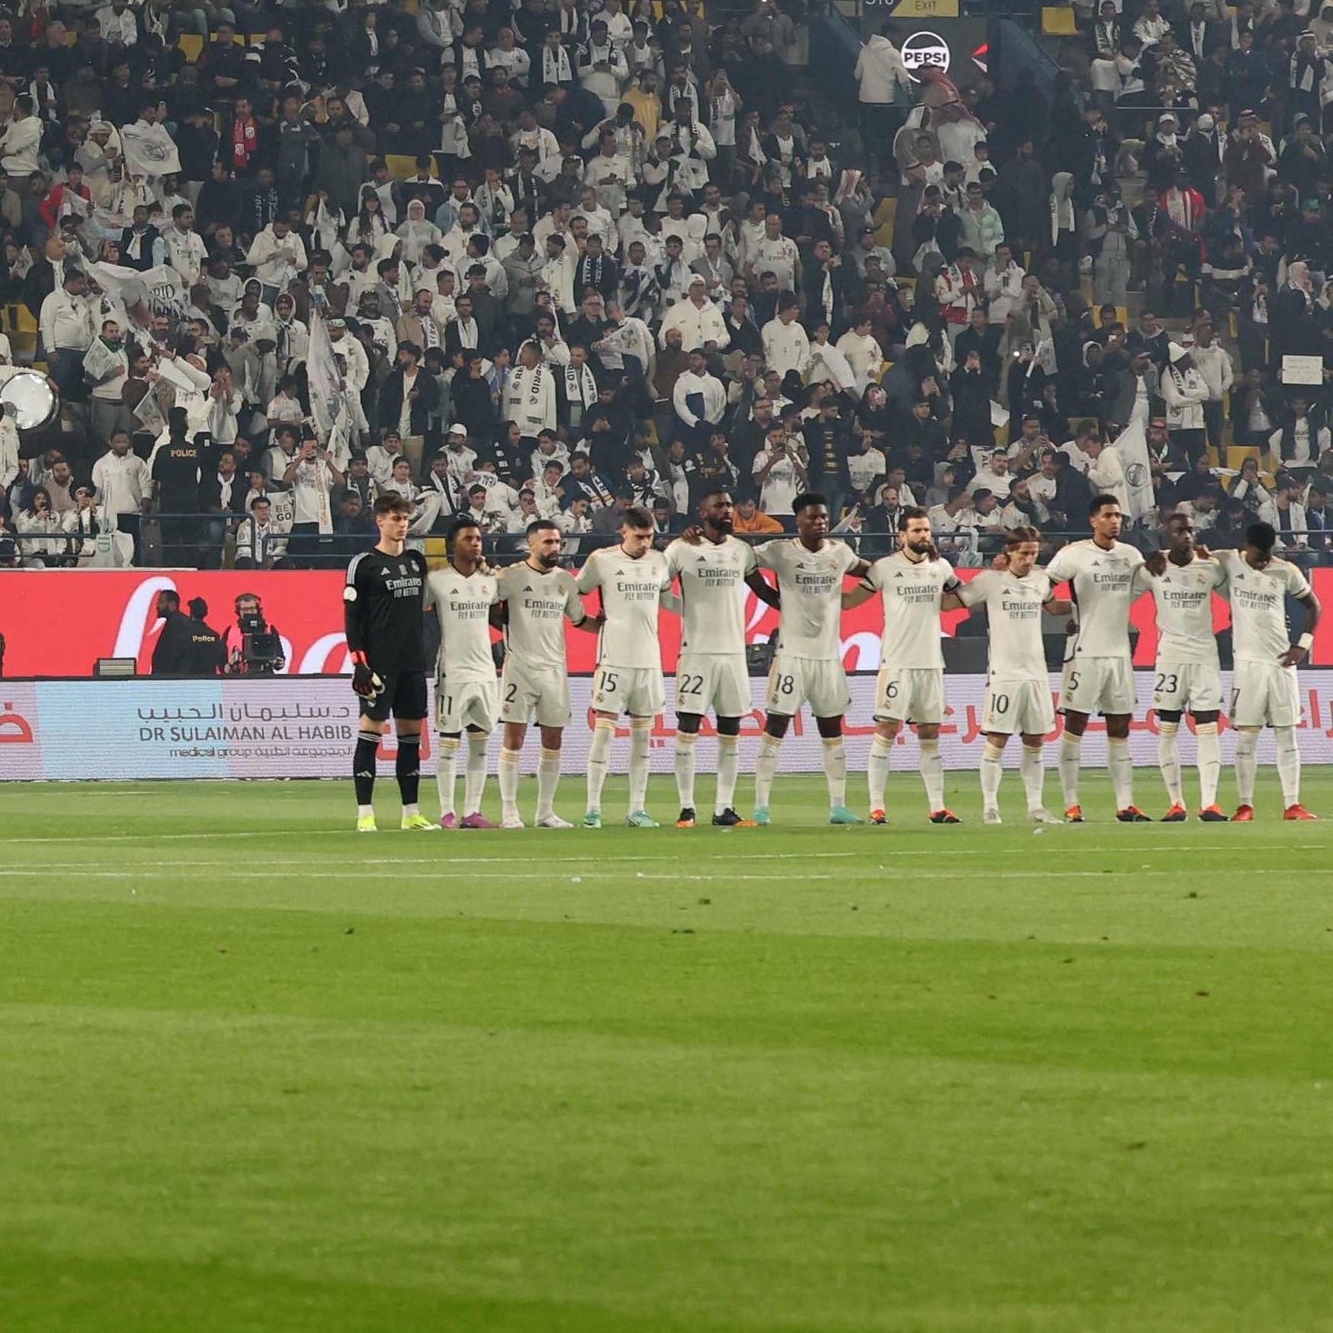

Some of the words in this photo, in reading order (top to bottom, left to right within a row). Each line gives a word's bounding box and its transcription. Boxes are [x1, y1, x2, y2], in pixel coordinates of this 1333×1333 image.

[915, 0, 937, 11] EXIT
[904, 52, 947, 63] PEPSI
[170, 449, 197, 457] POLICE
[276, 513, 292, 522] GO
[697, 568, 740, 578] Emirates
[795, 574, 837, 585] Emirates
[385, 577, 422, 591] Emirates
[617, 582, 659, 592] Emirates
[896, 584, 939, 596] Emirates
[1162, 589, 1207, 601] Emirates
[1234, 587, 1277, 602] Emirates
[192, 634, 215, 643] Police
[600, 671, 618, 692] 15
[679, 674, 703, 695] 22
[775, 673, 794, 695] 18
[1068, 671, 1081, 691] 5
[1154, 673, 1178, 693] 23
[505, 683, 517, 703] 2
[886, 680, 899, 698] 6
[440, 694, 452, 715] 11
[991, 693, 1009, 714] 10
[137, 703, 224, 723] الحبيب
[139, 726, 164, 741] DR
[170, 725, 265, 741] SULAIMAN
[271, 726, 293, 740] AL
[299, 725, 352, 740] HABIB
